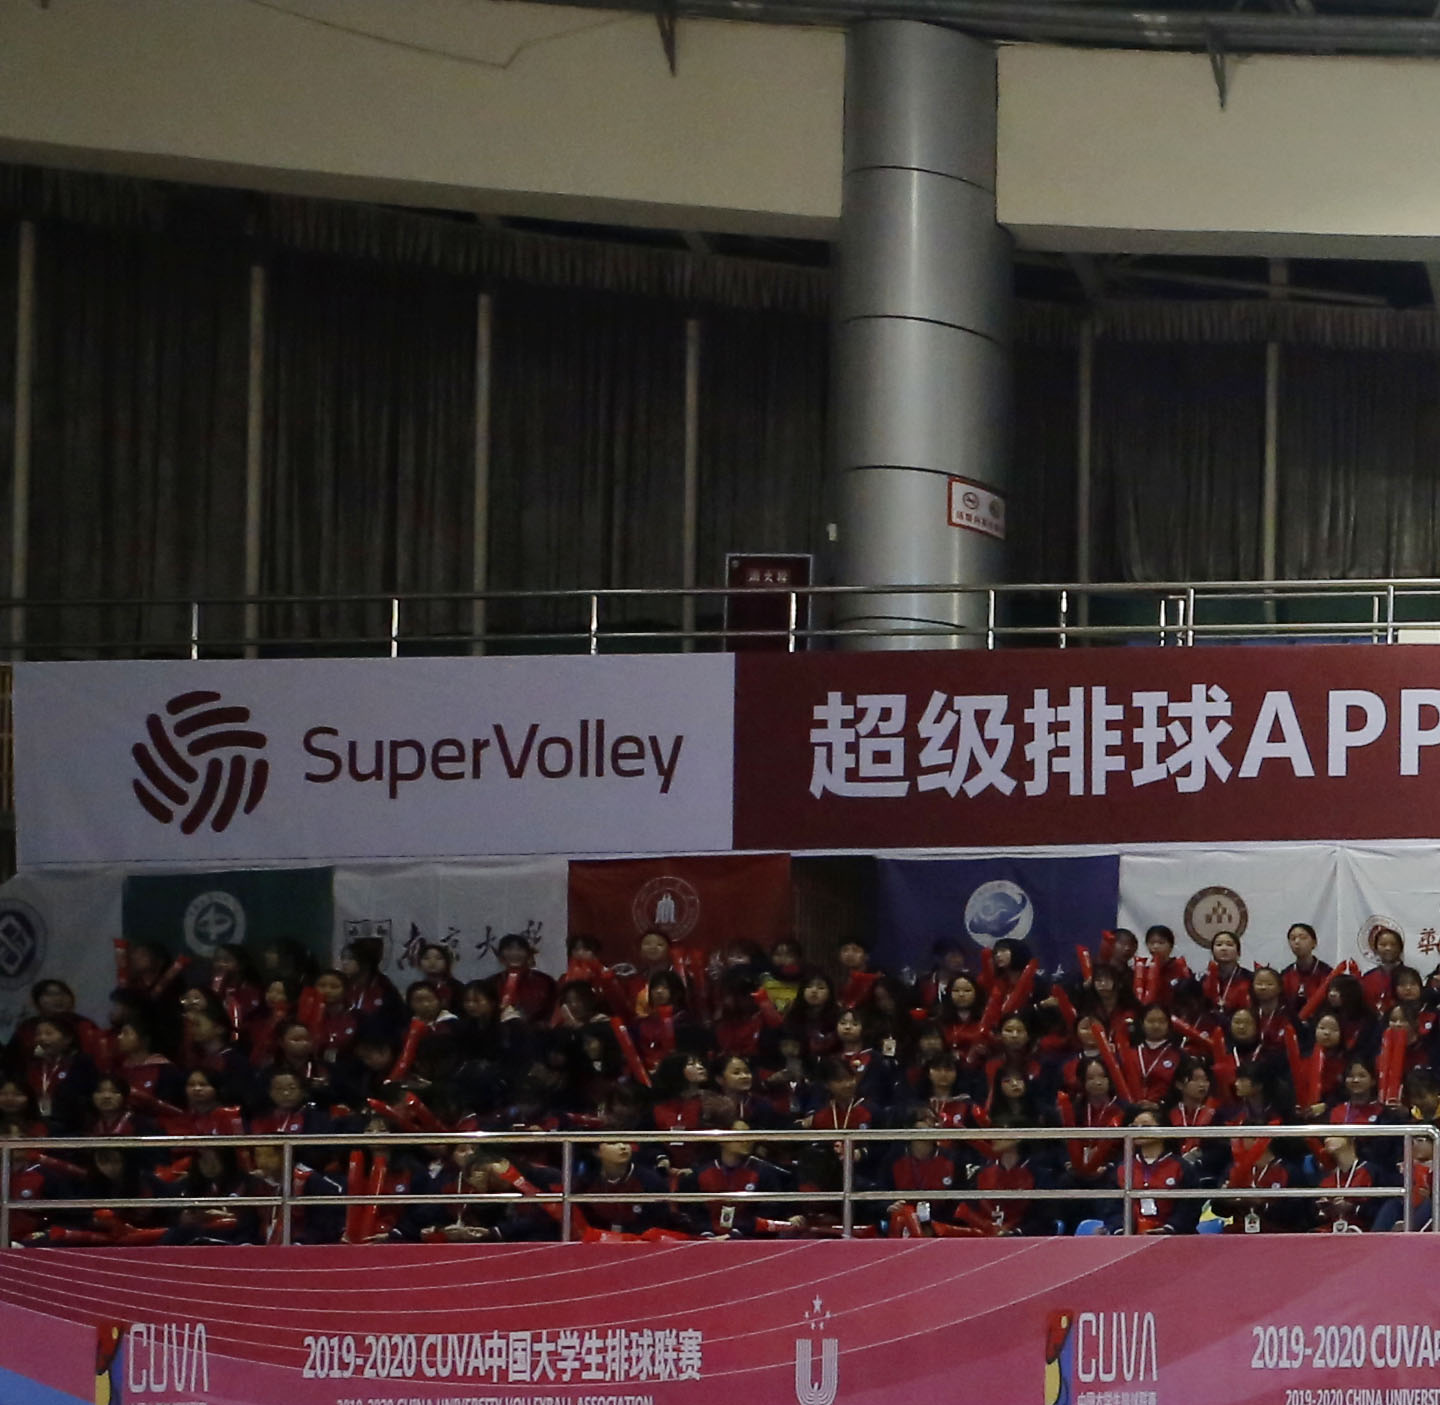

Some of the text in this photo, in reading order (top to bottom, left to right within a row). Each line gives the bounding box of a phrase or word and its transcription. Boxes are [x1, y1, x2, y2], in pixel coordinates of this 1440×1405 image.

[302, 719, 684, 798] SuperVolley
[129, 1323, 208, 1393] CUVA
[302, 1328, 703, 1386] 2019-2020 CUVA中国大学生排球联赛
[1077, 1312, 1159, 1383] CUVA
[1251, 1324, 1367, 1371] 2019-2020
